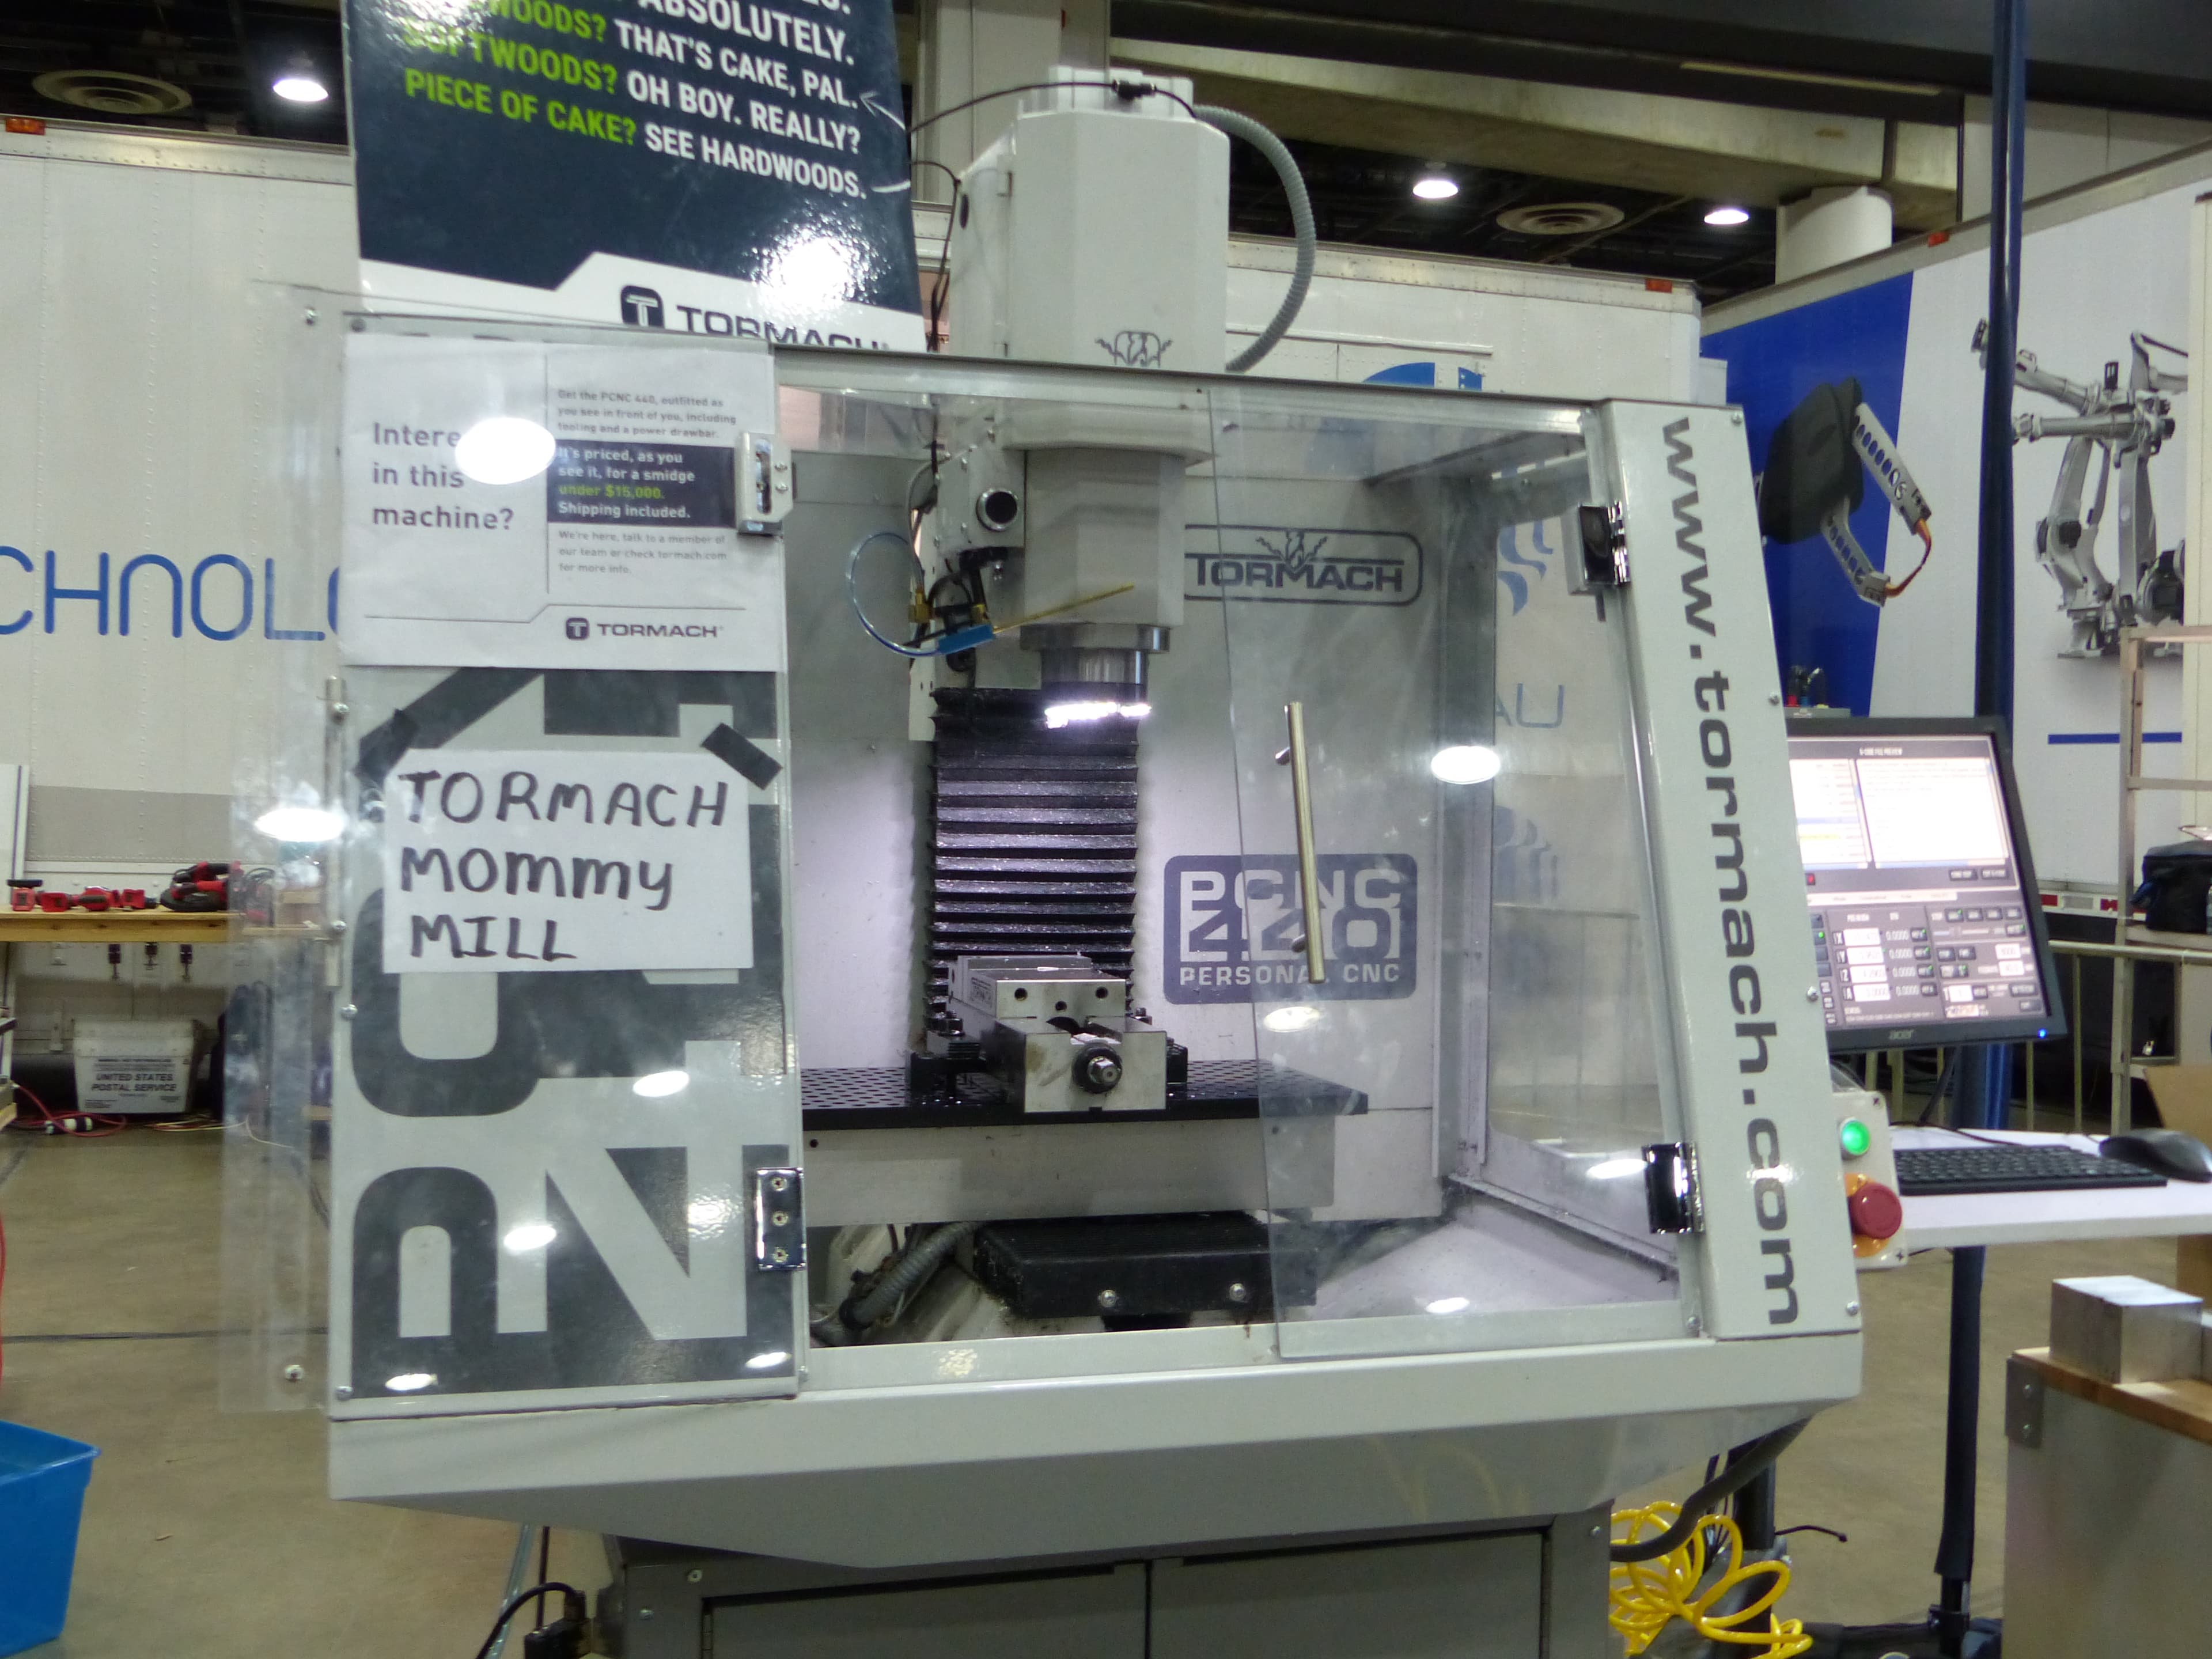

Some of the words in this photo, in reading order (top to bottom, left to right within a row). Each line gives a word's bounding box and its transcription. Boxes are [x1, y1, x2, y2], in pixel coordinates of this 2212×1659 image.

[613, 18, 713, 70] THAT'S
[719, 47, 796, 98] CAKE,
[802, 69, 859, 109] PAL.
[626, 69, 671, 108] OH
[678, 81, 743, 126] BOY.
[749, 99, 861, 154] REALLY?
[404, 67, 494, 115] PIECE
[501, 89, 539, 123] OF
[546, 100, 638, 146] CAKE?
[644, 121, 696, 161] SEE
[700, 134, 867, 200] HARDWOODS.
[676, 305, 879, 350] TORMA
[579, 391, 598, 400] the
[601, 392, 632, 403] PCNC
[661, 396, 709, 407] outfitted
[711, 399, 724, 407] as
[558, 408, 577, 418] you
[581, 409, 600, 417] see
[604, 408, 613, 418] in
[616, 409, 645, 420] front
[647, 410, 658, 421] of
[687, 412, 737, 426] including
[558, 423, 596, 434] tooling
[600, 423, 620, 434] and
[633, 427, 666, 438] power
[584, 449, 635, 463] priced,
[637, 452, 655, 463] as
[658, 453, 684, 465] you
[373, 462, 399, 486] in
[410, 464, 465, 488] this
[558, 468, 585, 478] see
[586, 467, 603, 479] it,
[606, 468, 628, 479] for
[630, 471, 641, 480] a
[643, 470, 696, 484] smidge
[558, 484, 601, 497] under
[373, 505, 515, 531] machine?
[558, 502, 622, 518] Shipping
[624, 503, 691, 519] included.
[622, 533, 643, 543] talk
[646, 533, 657, 543] to
[668, 535, 711, 545] member
[714, 535, 726, 544] of
[558, 548, 577, 557] our
[580, 548, 607, 558] team
[609, 550, 622, 558] or
[624, 549, 656, 559] check
[558, 562, 577, 573] for
[578, 564, 607, 574] more
[1185, 552, 1404, 593] TORMACH
[0, 545, 340, 641] CHNOL
[596, 623, 719, 638] TORMACH
[1661, 416, 1800, 1327] www.tormach.com
[1180, 868, 1402, 910] PCNC
[411, 914, 578, 962] MILL
[1180, 966, 1326, 986] PERSONA
[1343, 964, 1400, 984] CNC
